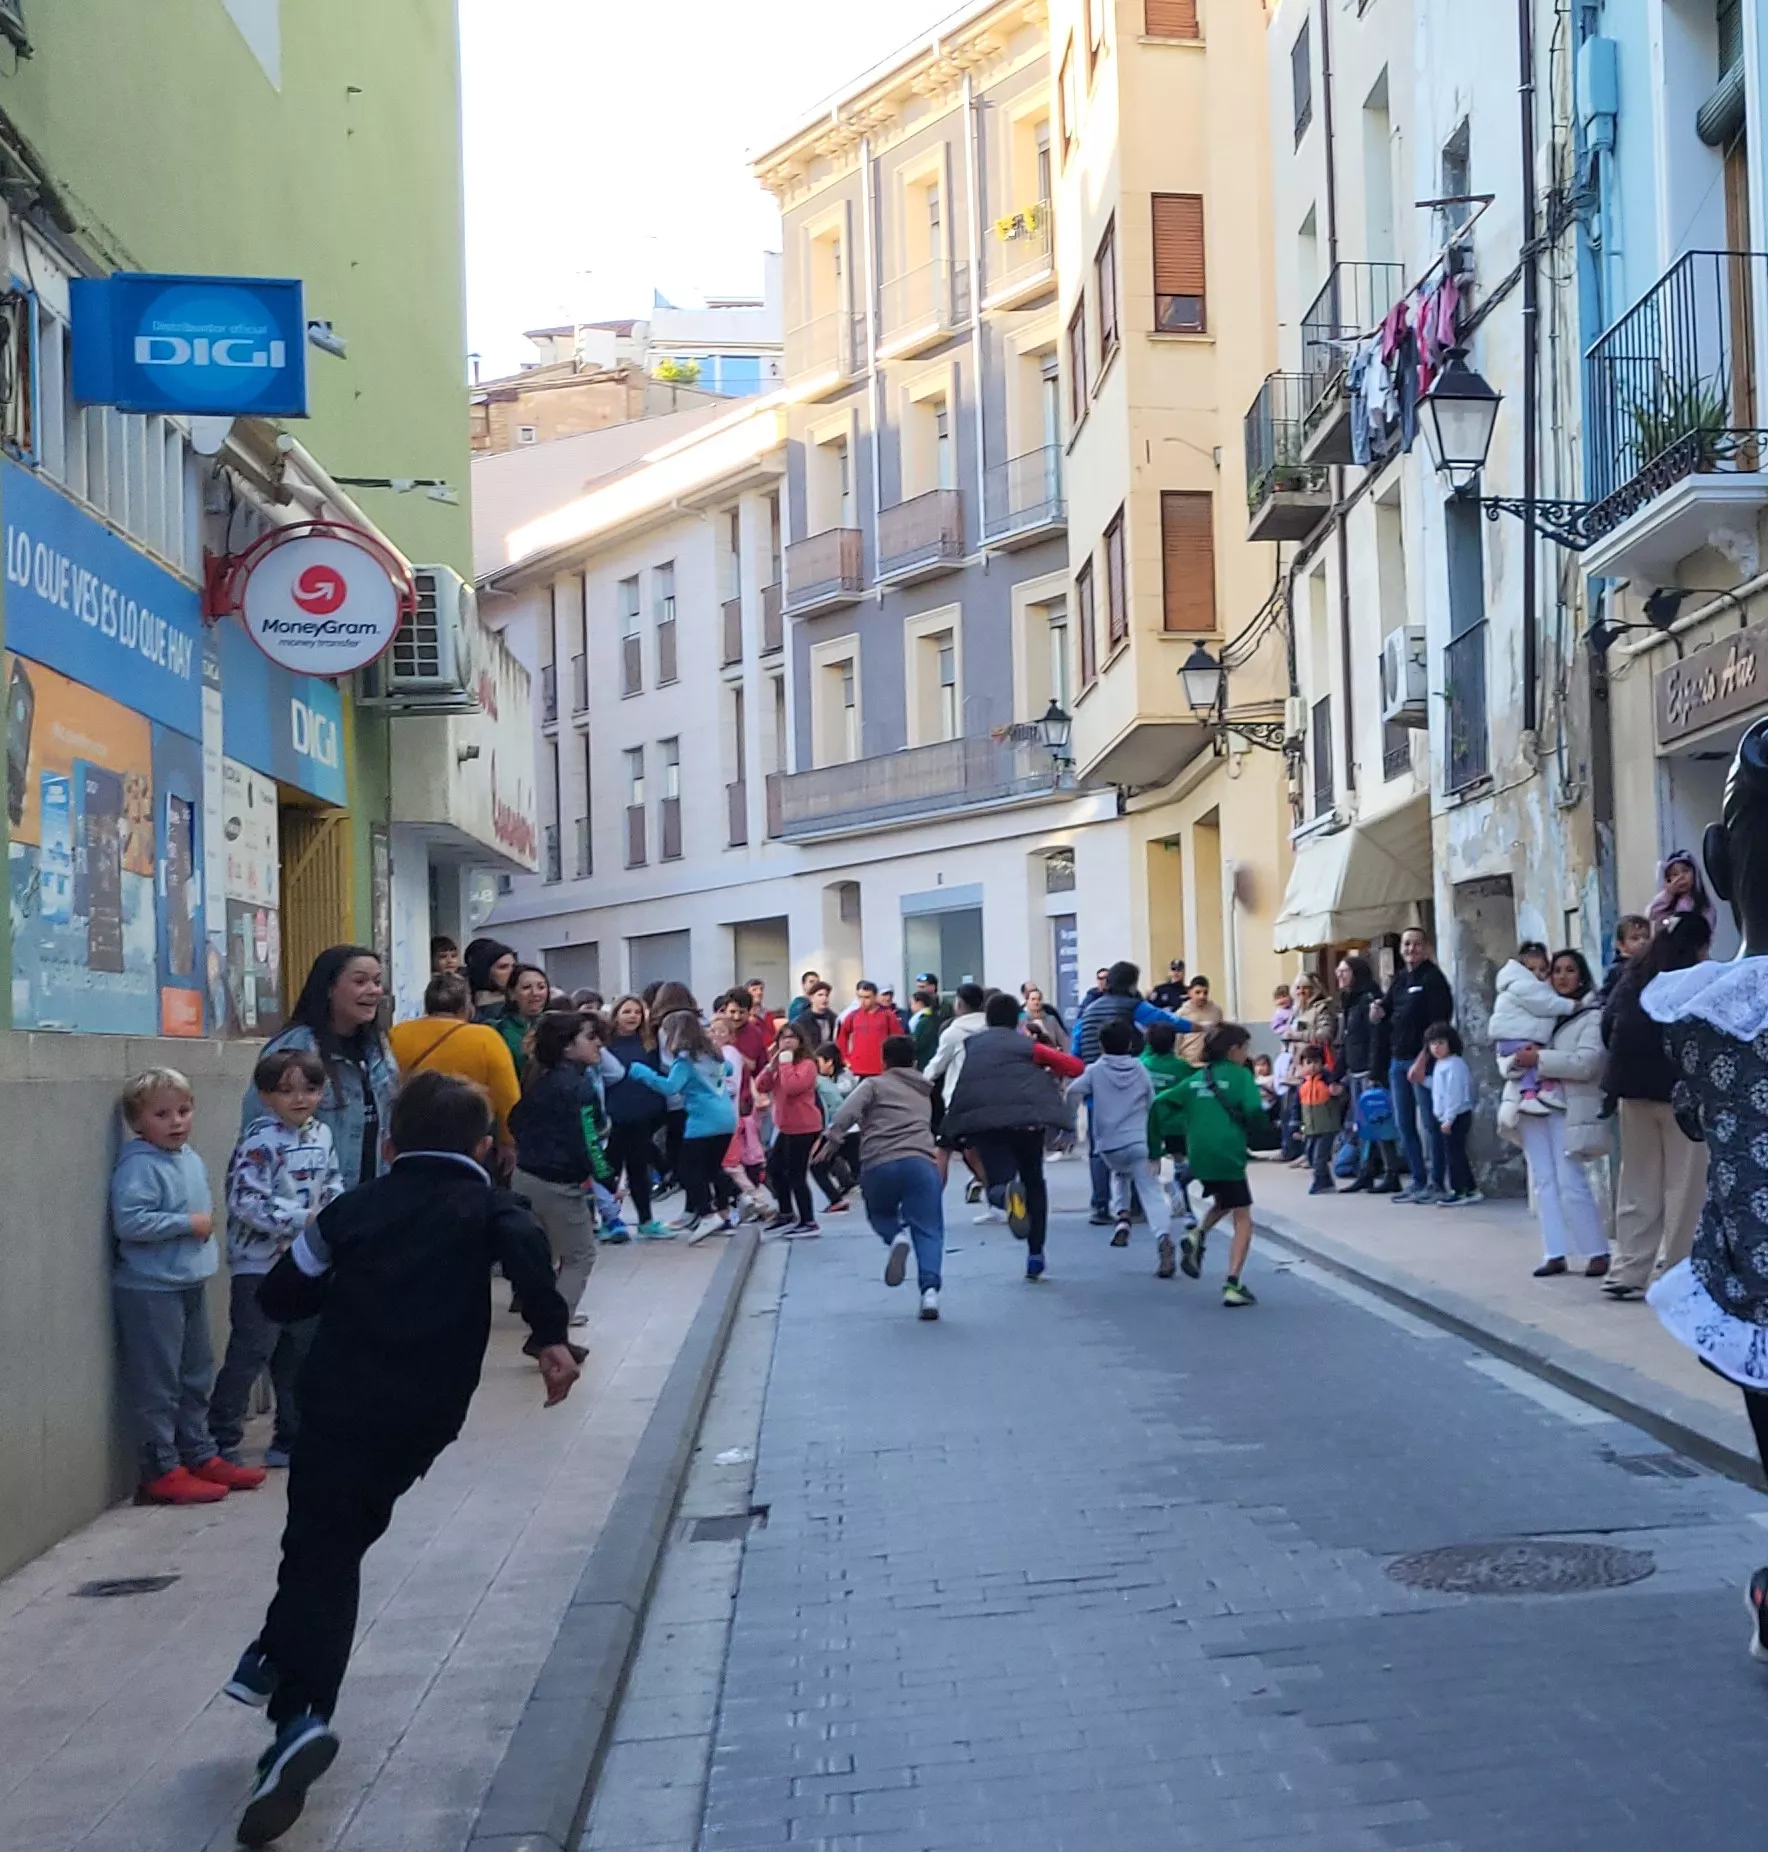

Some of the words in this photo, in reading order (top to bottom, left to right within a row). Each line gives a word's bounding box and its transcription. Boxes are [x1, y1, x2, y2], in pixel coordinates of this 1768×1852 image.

[134, 335, 286, 368] DIGI
[7, 524, 31, 587] LO
[34, 542, 70, 609] QUE
[71, 564, 99, 627] VES
[101, 579, 118, 637] ES
[119, 595, 138, 649] LO
[139, 608, 167, 667] QUE
[168, 625, 194, 681] HAY
[261, 618, 378, 638] MoneyGram
[277, 638, 316, 649] money
[317, 637, 361, 648] transfer
[290, 697, 338, 769] DIGI
